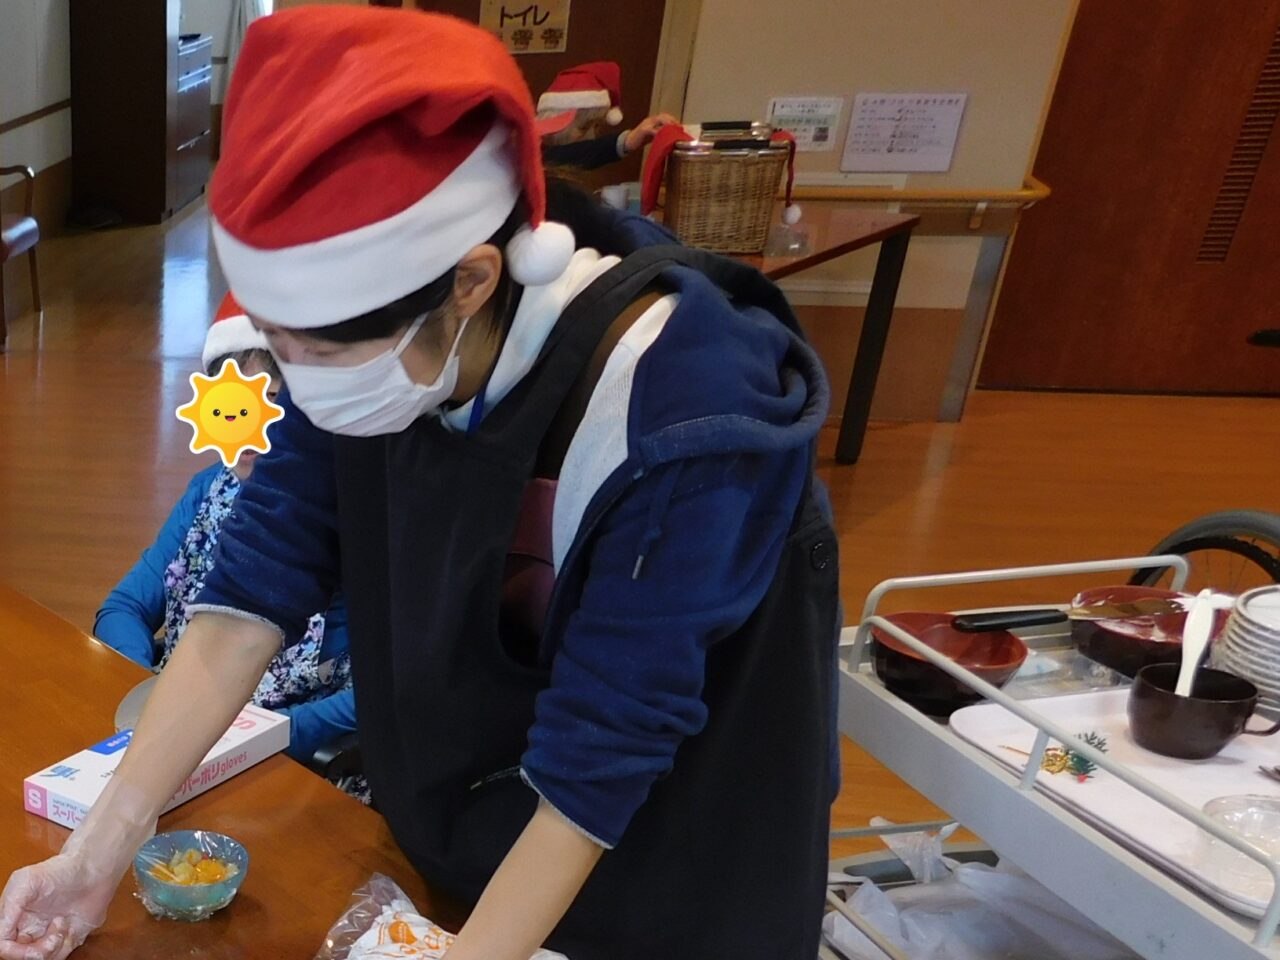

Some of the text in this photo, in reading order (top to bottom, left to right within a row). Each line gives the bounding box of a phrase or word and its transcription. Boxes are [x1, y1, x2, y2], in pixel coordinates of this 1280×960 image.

[499, 4, 550, 28] トイレ
[28, 788, 42, 809] S
